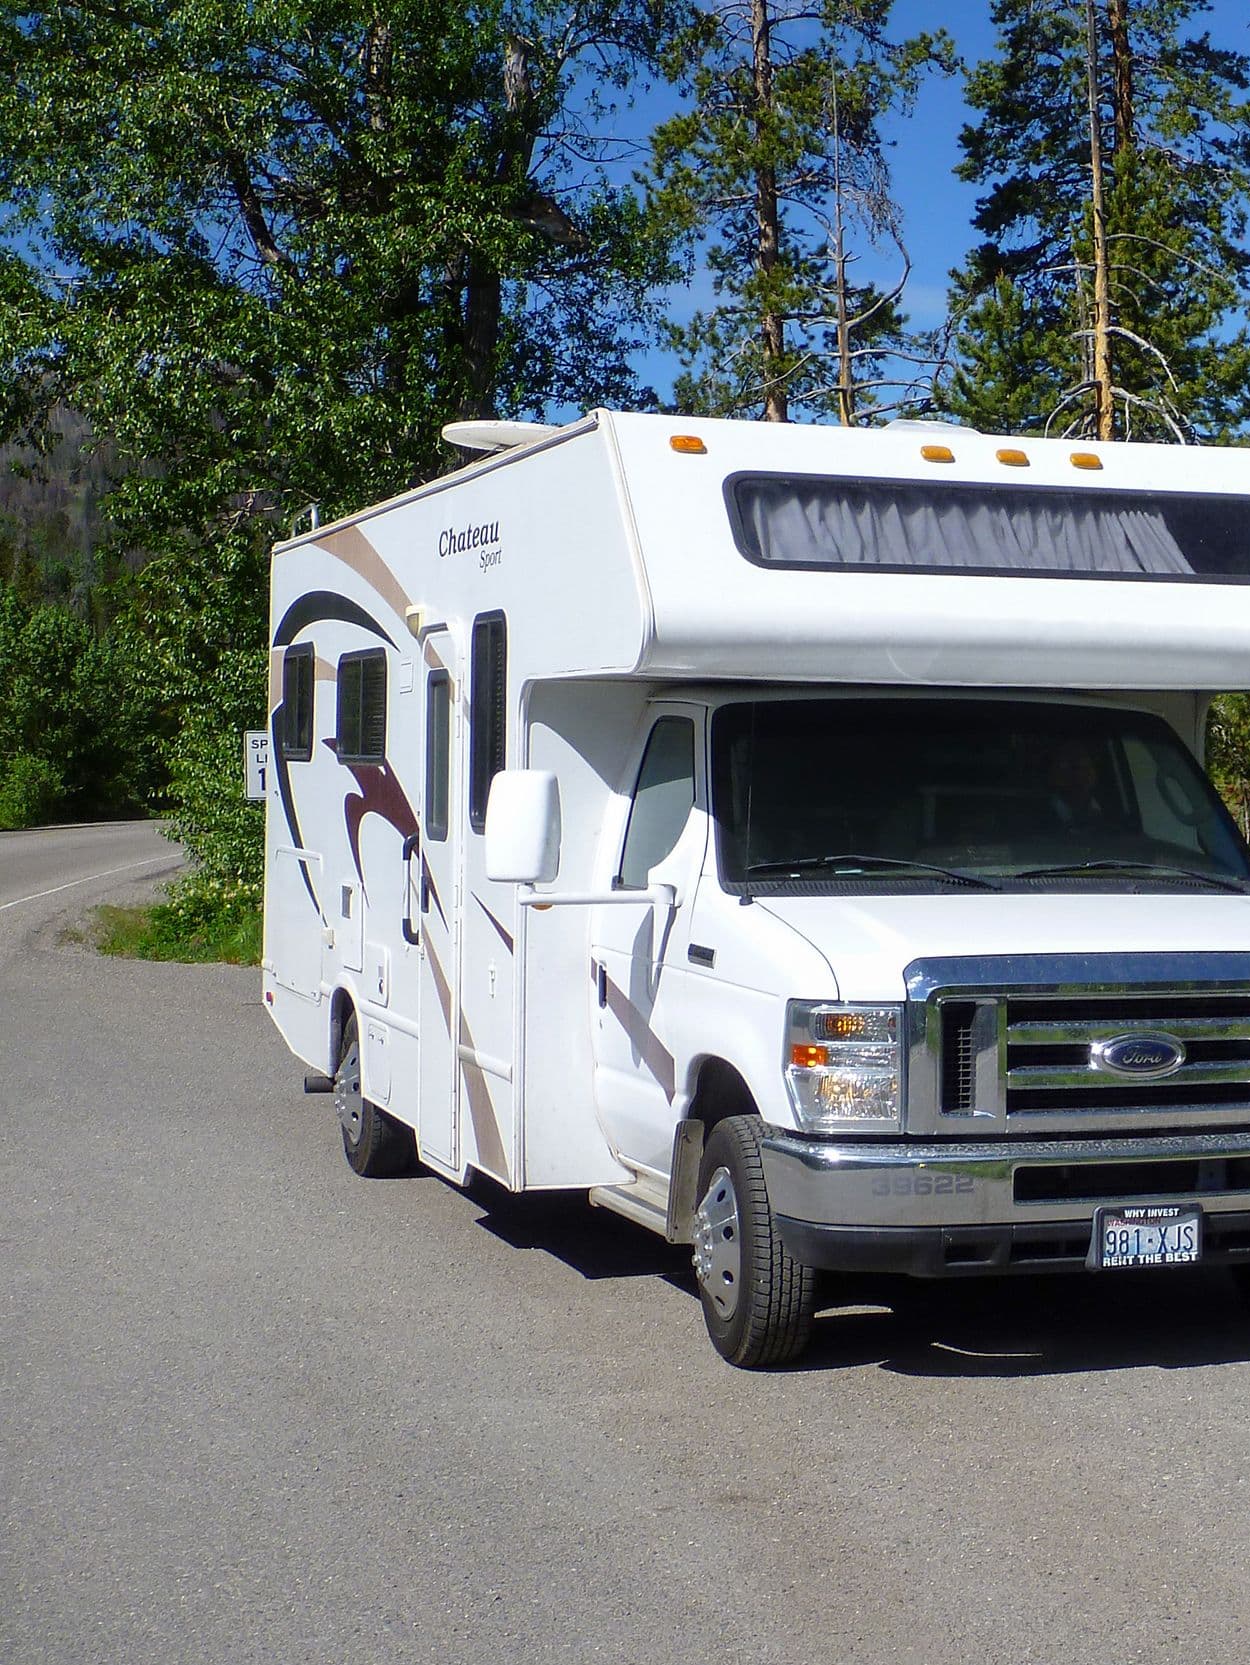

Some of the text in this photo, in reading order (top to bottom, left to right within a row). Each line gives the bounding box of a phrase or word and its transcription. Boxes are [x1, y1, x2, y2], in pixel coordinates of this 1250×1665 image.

[439, 520, 500, 558] Chateau
[480, 547, 502, 573] Sport
[251, 739, 268, 750] SP
[256, 754, 268, 763] LI
[258, 767, 266, 791] 1
[1122, 1045, 1163, 1064] Ford
[1124, 1208, 1179, 1218] WHY INVEST
[1103, 1252, 1198, 1267] RENT THE BEST
